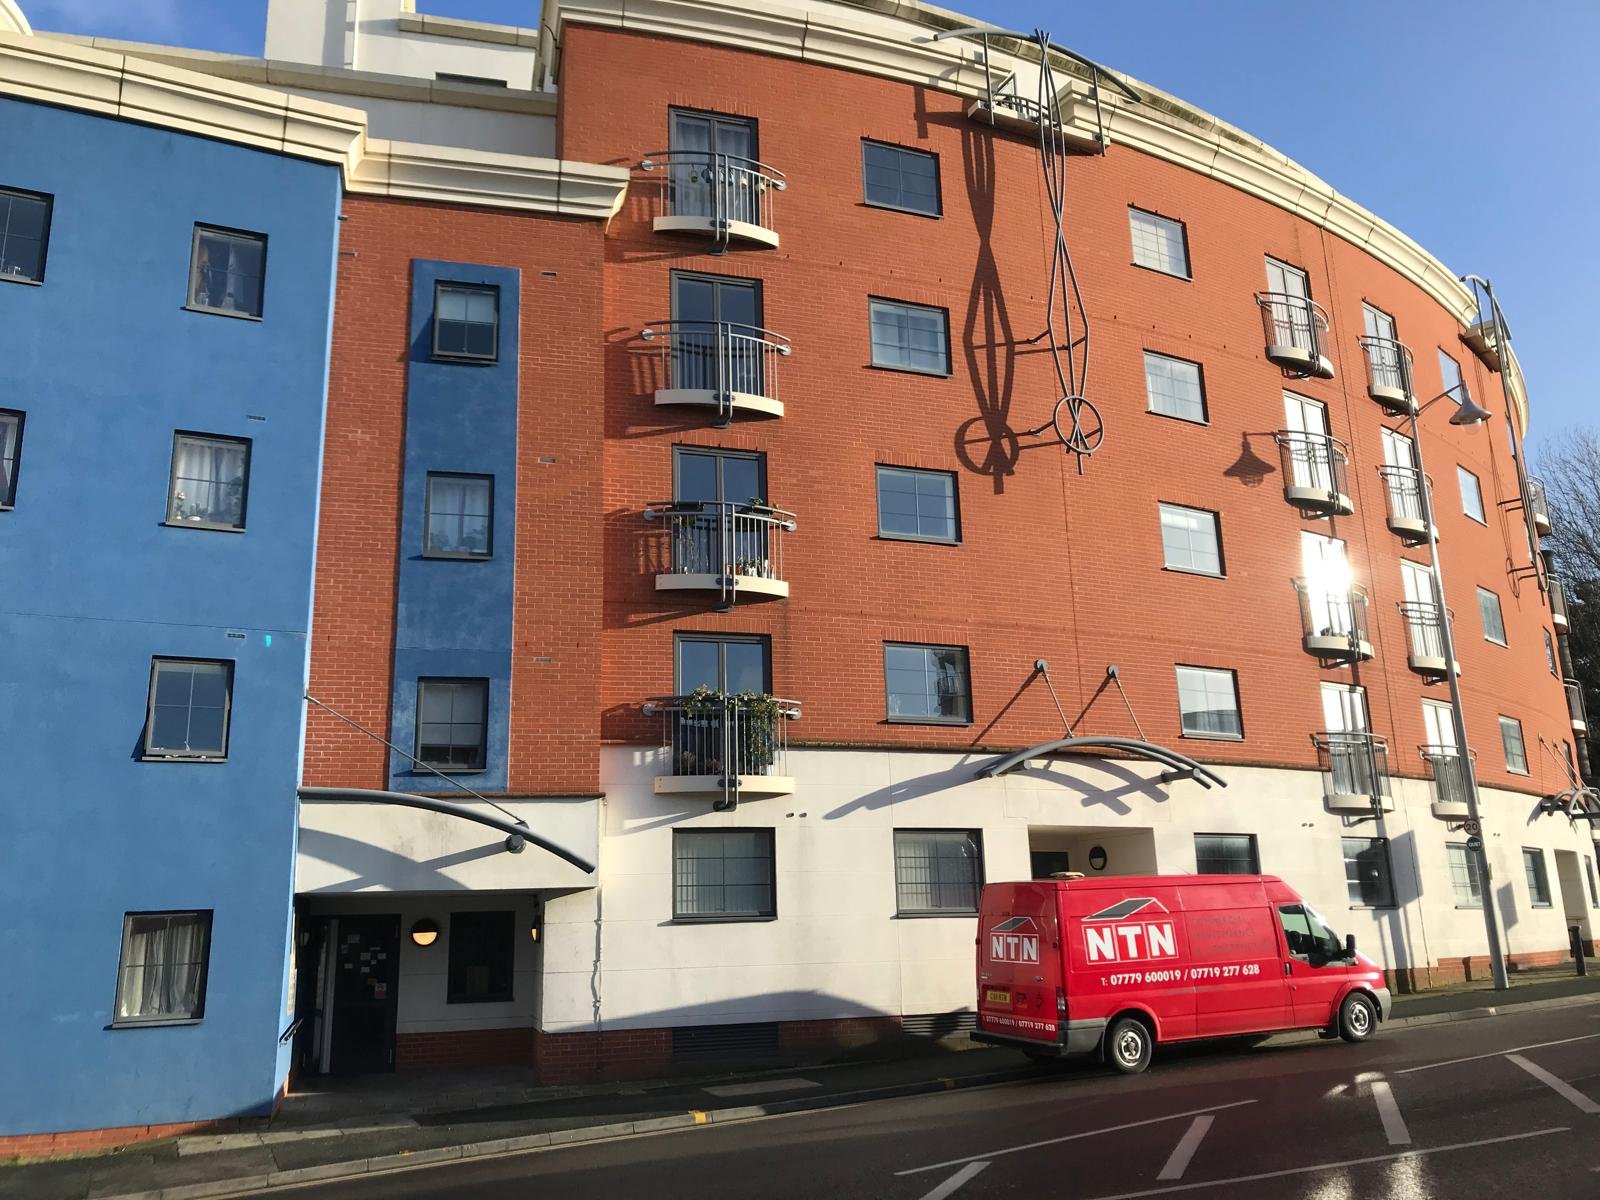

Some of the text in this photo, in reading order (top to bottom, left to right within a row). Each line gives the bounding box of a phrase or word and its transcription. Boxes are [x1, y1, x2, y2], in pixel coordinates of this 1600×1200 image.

[992, 937, 1037, 960] NTN
[1086, 924, 1175, 961] NTN
[1110, 972, 1142, 986] 07779
[1145, 969, 1181, 983] 600019
[1190, 966, 1220, 980] 07719
[1223, 965, 1240, 977] 277
[1242, 963, 1260, 976] 628
[1018, 1020, 1034, 1028] 07719
[1034, 1022, 1044, 1030] 277
[1045, 1023, 1056, 1031] 628
